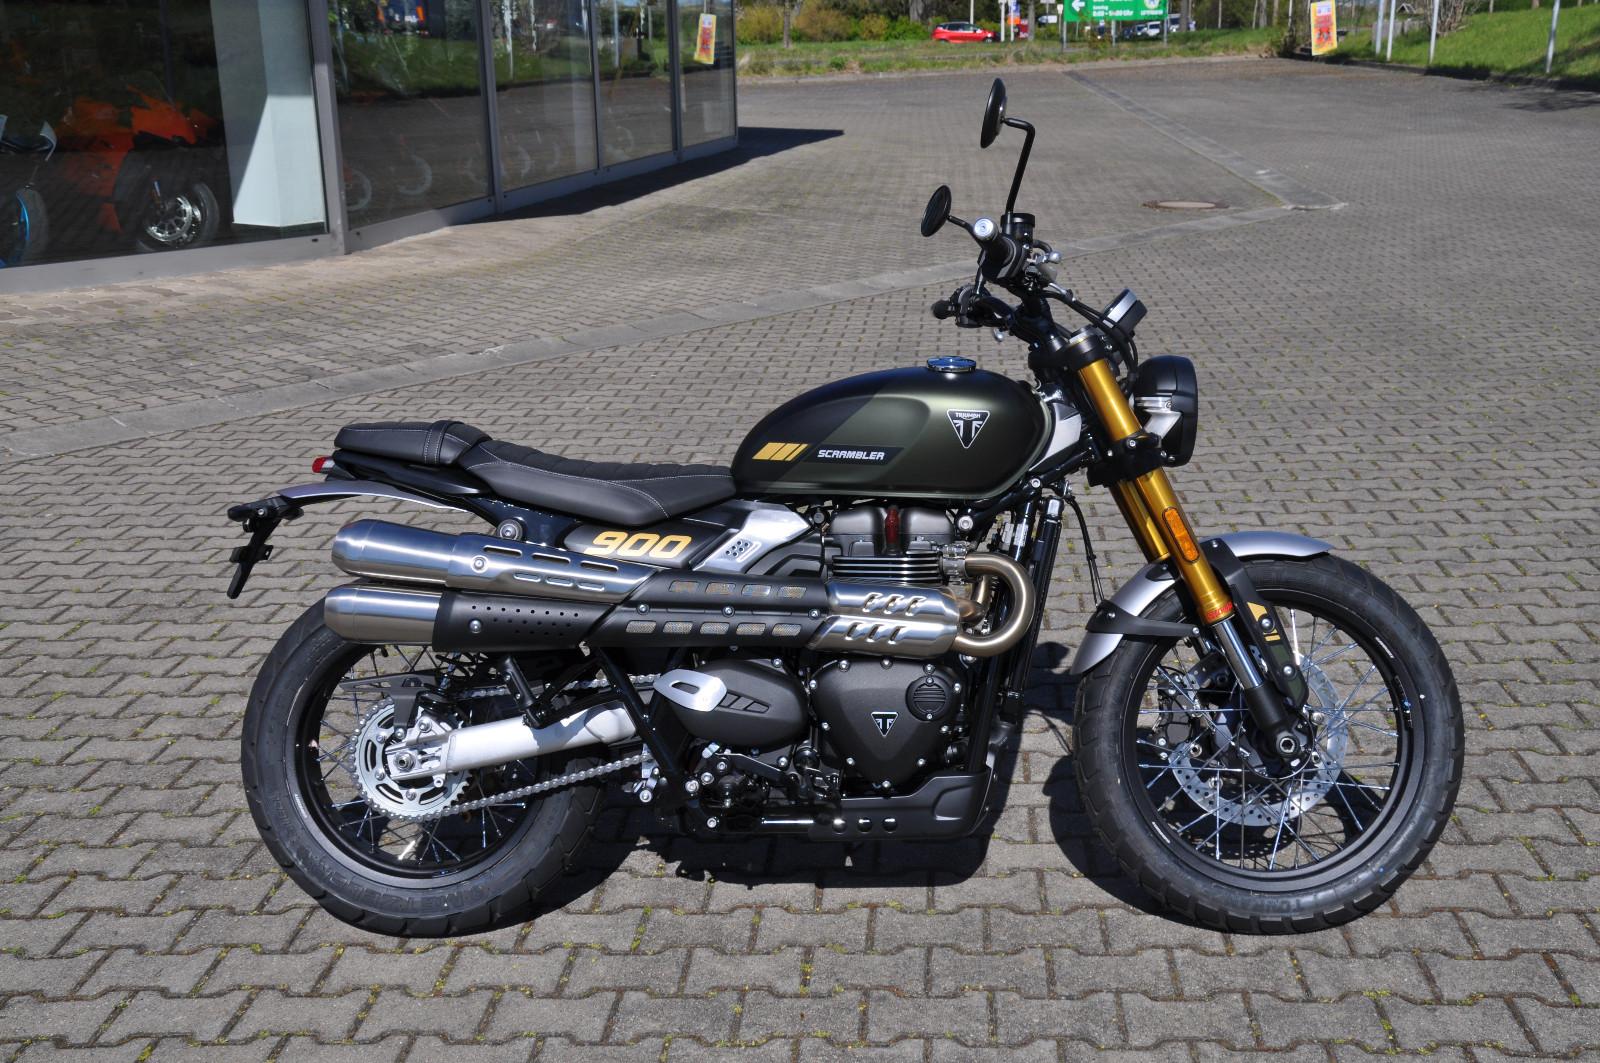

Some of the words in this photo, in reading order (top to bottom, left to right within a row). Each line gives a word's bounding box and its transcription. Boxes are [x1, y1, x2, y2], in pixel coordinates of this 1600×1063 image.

[955, 412, 981, 420] TRIUMPH
[817, 449, 886, 462] SCRAMBLER
[583, 530, 692, 559] 900
